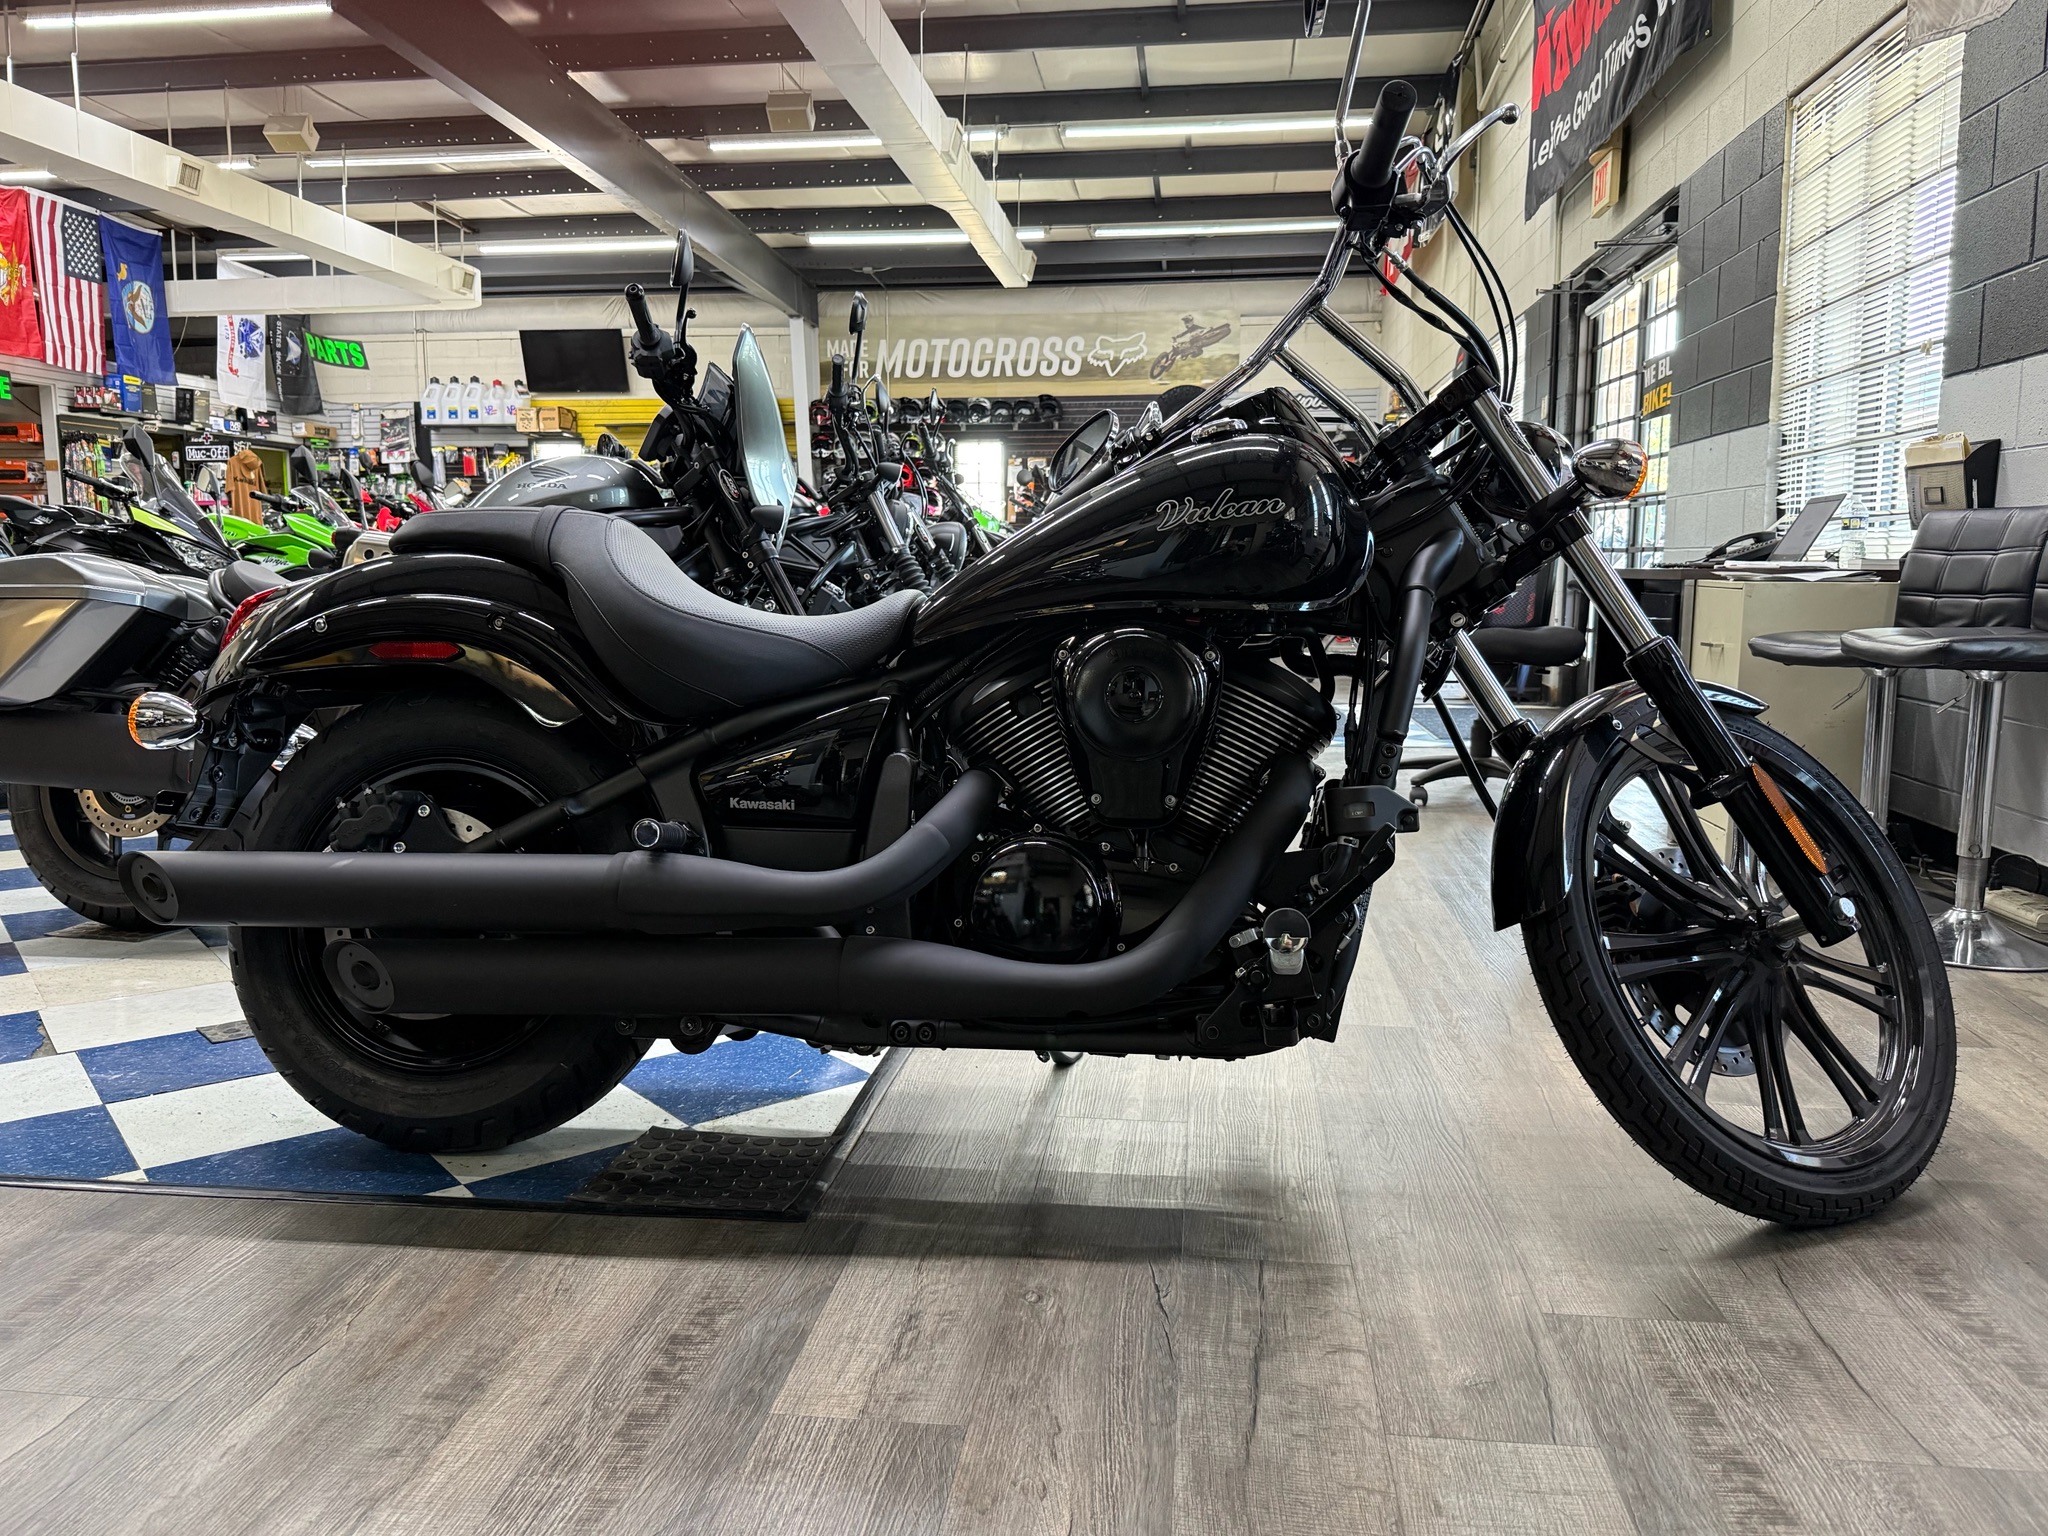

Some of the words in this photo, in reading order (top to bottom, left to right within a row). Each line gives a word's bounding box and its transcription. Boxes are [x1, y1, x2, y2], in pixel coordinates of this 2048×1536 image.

[1573, 59, 1603, 131] Good
[1604, 13, 1651, 89] Times
[1594, 161, 1608, 206] EXIT
[305, 332, 365, 367] PARTS
[876, 336, 1085, 379] MOTOCROSS
[187, 447, 228, 460] Muc-Off
[1156, 488, 1286, 532] Vulcan
[729, 797, 796, 811] Kawasaki
